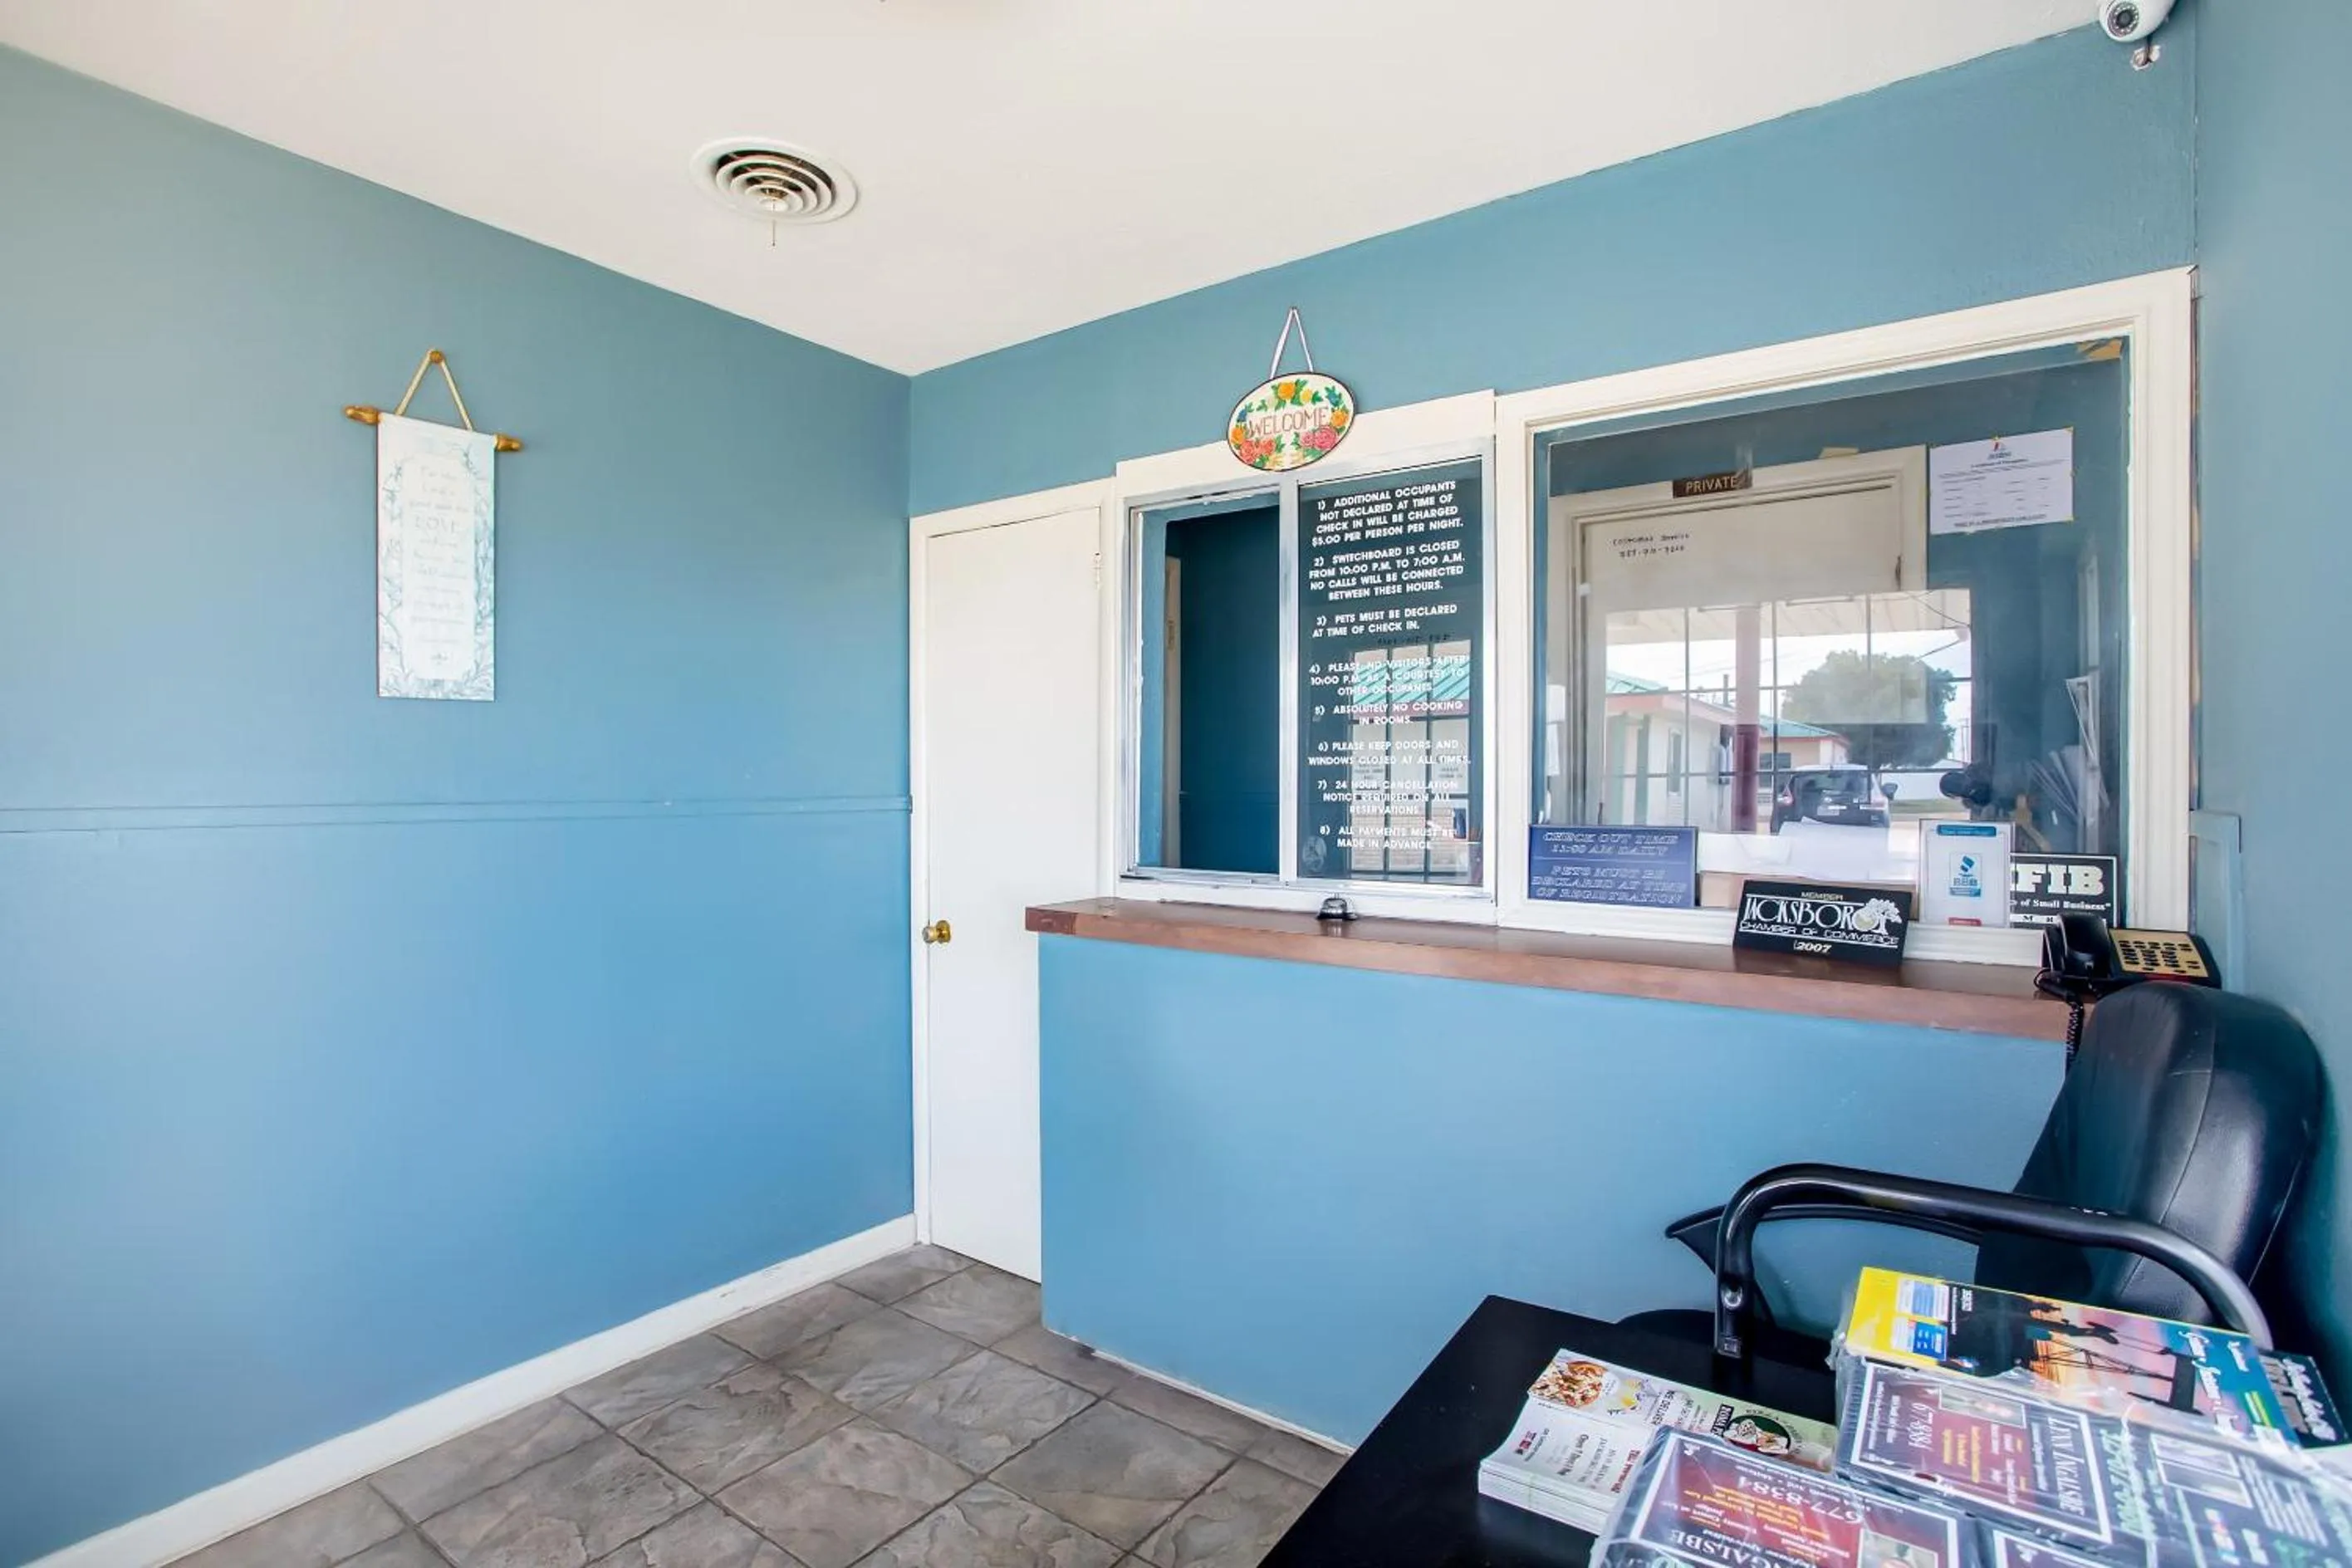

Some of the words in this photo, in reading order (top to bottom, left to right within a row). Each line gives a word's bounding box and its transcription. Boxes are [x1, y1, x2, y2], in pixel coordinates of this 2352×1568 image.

[1247, 406, 1329, 437] WELCOME
[1686, 476, 1737, 493] PRIVATE
[1318, 502, 1325, 511] 1)
[1334, 492, 1391, 507] ADDITIONAL
[1395, 482, 1456, 497] OCCUPANTS
[1320, 512, 1339, 522] NOT
[1344, 503, 1393, 518] DECLARED
[1397, 501, 1409, 511] AT
[1413, 497, 1435, 507] TIME
[1439, 493, 1453, 503] OF
[1316, 522, 1348, 534] CHECK
[1353, 519, 1363, 528] IN
[1367, 516, 1388, 526] WILL
[1392, 513, 1404, 523] BE
[1408, 506, 1458, 520] CHARGED
[1312, 535, 1340, 547] $5.00
[1345, 532, 1361, 541] PER
[1365, 527, 1403, 539] PERSON
[1408, 522, 1424, 532] PER
[1429, 517, 1463, 531] NIGHT.
[1314, 557, 1324, 566] 2)
[1333, 547, 1402, 564] SWITCHBOARD
[1406, 546, 1415, 555] IS
[1419, 541, 1459, 553] CLOSED
[1309, 567, 1335, 579] FROM
[1340, 564, 1368, 575] 10:00
[1372, 561, 1391, 571] P.M.
[1396, 558, 1409, 568] TO
[1414, 555, 1438, 566] 7:00
[1442, 552, 1465, 563] A.M.
[1311, 581, 1325, 590] NO
[1329, 576, 1357, 588] CALLS
[1360, 574, 1382, 584] WILL
[1386, 572, 1398, 582] BE
[1402, 566, 1463, 579] CONNECTED
[1329, 588, 1370, 600] BETWEEN
[1374, 584, 1402, 595] THESE
[1407, 581, 1443, 592] HOURS.
[1316, 615, 1326, 625] 3)
[1335, 612, 1355, 623] PETS
[1359, 610, 1384, 620] MUST
[1389, 608, 1400, 618] BE
[1404, 605, 1457, 617] DECLARED
[1312, 628, 1324, 638] AT
[1326, 625, 1347, 635] TIME
[1352, 624, 1365, 634] OF
[1369, 621, 1402, 633] CHECK
[1407, 620, 1420, 630] IN.
[1309, 664, 1321, 674] 4)
[1386, 657, 1431, 667] VISITORS
[1435, 654, 1469, 664] AFTER
[1311, 677, 1340, 685] 10:00
[1384, 673, 1391, 681] A
[1395, 669, 1445, 679] COURTESY
[1337, 687, 1368, 696] OTHER
[1333, 703, 1388, 714] ABSOLUTELY
[1393, 703, 1409, 712] NO
[1412, 701, 1463, 711] COOKING
[1359, 718, 1370, 726] IN
[1374, 716, 1414, 725] ROOMS.
[1318, 742, 1328, 751] 6)
[1332, 742, 1365, 751] PLEASE
[1369, 742, 1392, 750] KEEP
[1395, 741, 1432, 750] DOORS
[1436, 739, 1459, 749] AND
[1308, 757, 1354, 766] WINDOWS
[1358, 757, 1396, 765] CLOSED
[1403, 756, 1413, 764] AT
[1417, 755, 1435, 765] ALL
[1335, 781, 1347, 789] 24
[1352, 781, 1377, 789] HOUR
[1382, 780, 1458, 789] CANCELLATION
[1323, 792, 1357, 801] NOTICE
[1361, 792, 1409, 801] REQUIRED
[1414, 792, 1428, 801] ON
[1433, 793, 1450, 801] ALL
[1320, 826, 1330, 835] 8)
[1339, 826, 1354, 835] ALL
[1359, 826, 1407, 836] PAYMENTS
[1411, 826, 1437, 836] MUST
[1543, 832, 1596, 843] CHECK
[1599, 833, 1630, 843] OUT
[1635, 835, 1678, 844] TIME
[1337, 839, 1365, 848] MADE
[1369, 839, 1379, 848] IN
[1551, 845, 1586, 854] 11:00
[1618, 846, 1668, 855] DAILY
[1551, 865, 1590, 876] PETS
[1594, 867, 1639, 877] MUST
[1642, 870, 1665, 880] BE
[2010, 864, 2104, 895] FIB
[1531, 876, 1615, 889] DECLARED
[1618, 881, 1640, 889] AT
[1644, 882, 1687, 892] TIME
[1536, 888, 1557, 898] OF
[1559, 889, 1682, 904] REGISTRATION
[1801, 892, 1844, 901] MEMBER
[2033, 899, 2060, 909] Small
[1740, 920, 1797, 934] CHAMBER
[1801, 928, 1818, 936] OF
[1824, 930, 1899, 945] COMMERCE
[1795, 940, 1832, 953] 2007
[1737, 1476, 1864, 1524] 677-8384
